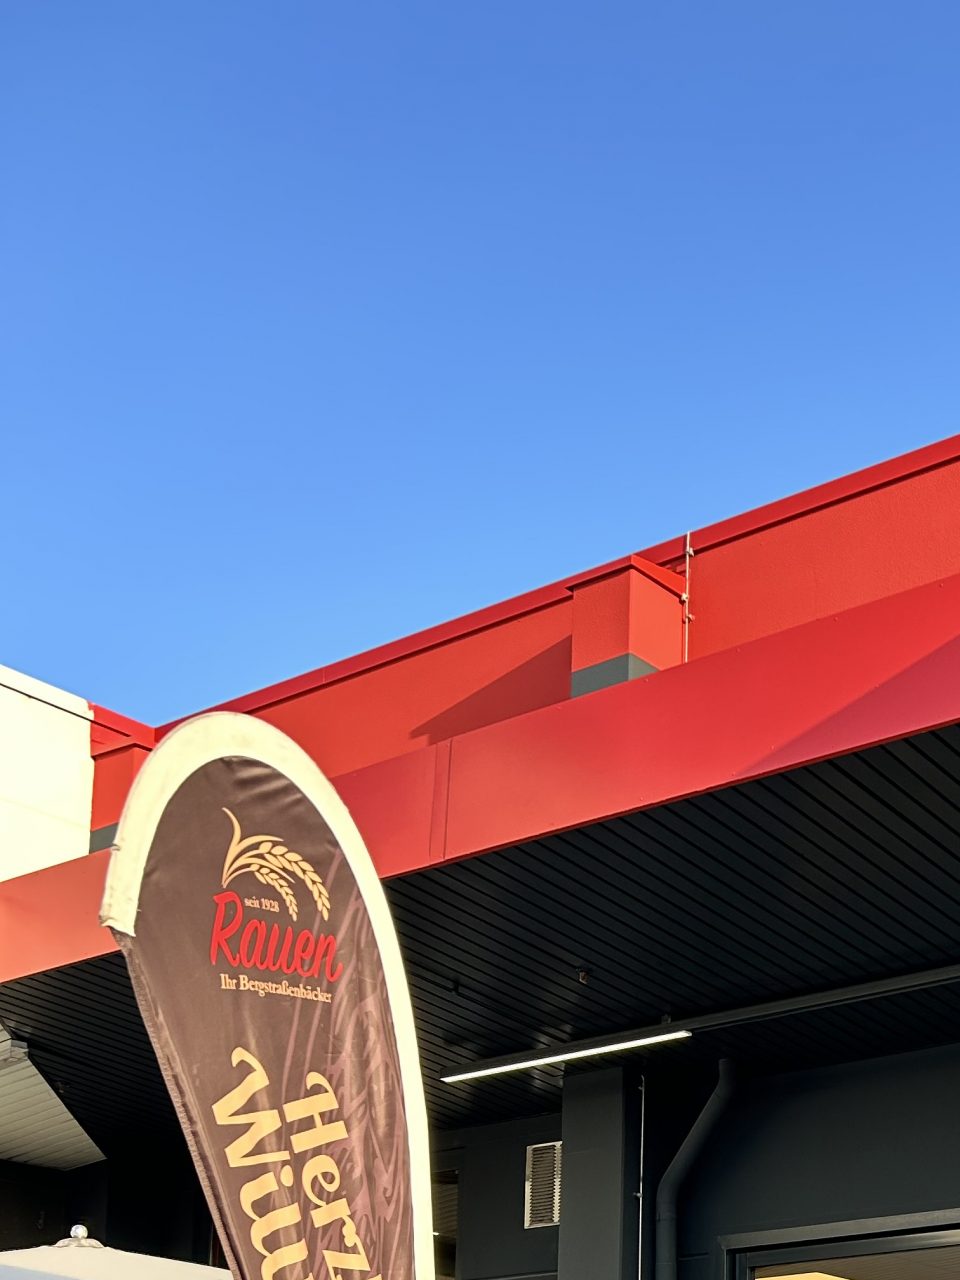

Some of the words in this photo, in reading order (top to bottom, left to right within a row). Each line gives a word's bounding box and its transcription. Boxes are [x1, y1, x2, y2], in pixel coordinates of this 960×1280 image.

[244, 896, 260, 908] seit
[261, 898, 279, 912] 1928
[209, 891, 343, 983] Rauen
[220, 973, 237, 989] Ihr
[239, 975, 332, 1003] Bergstraßenbäcker
